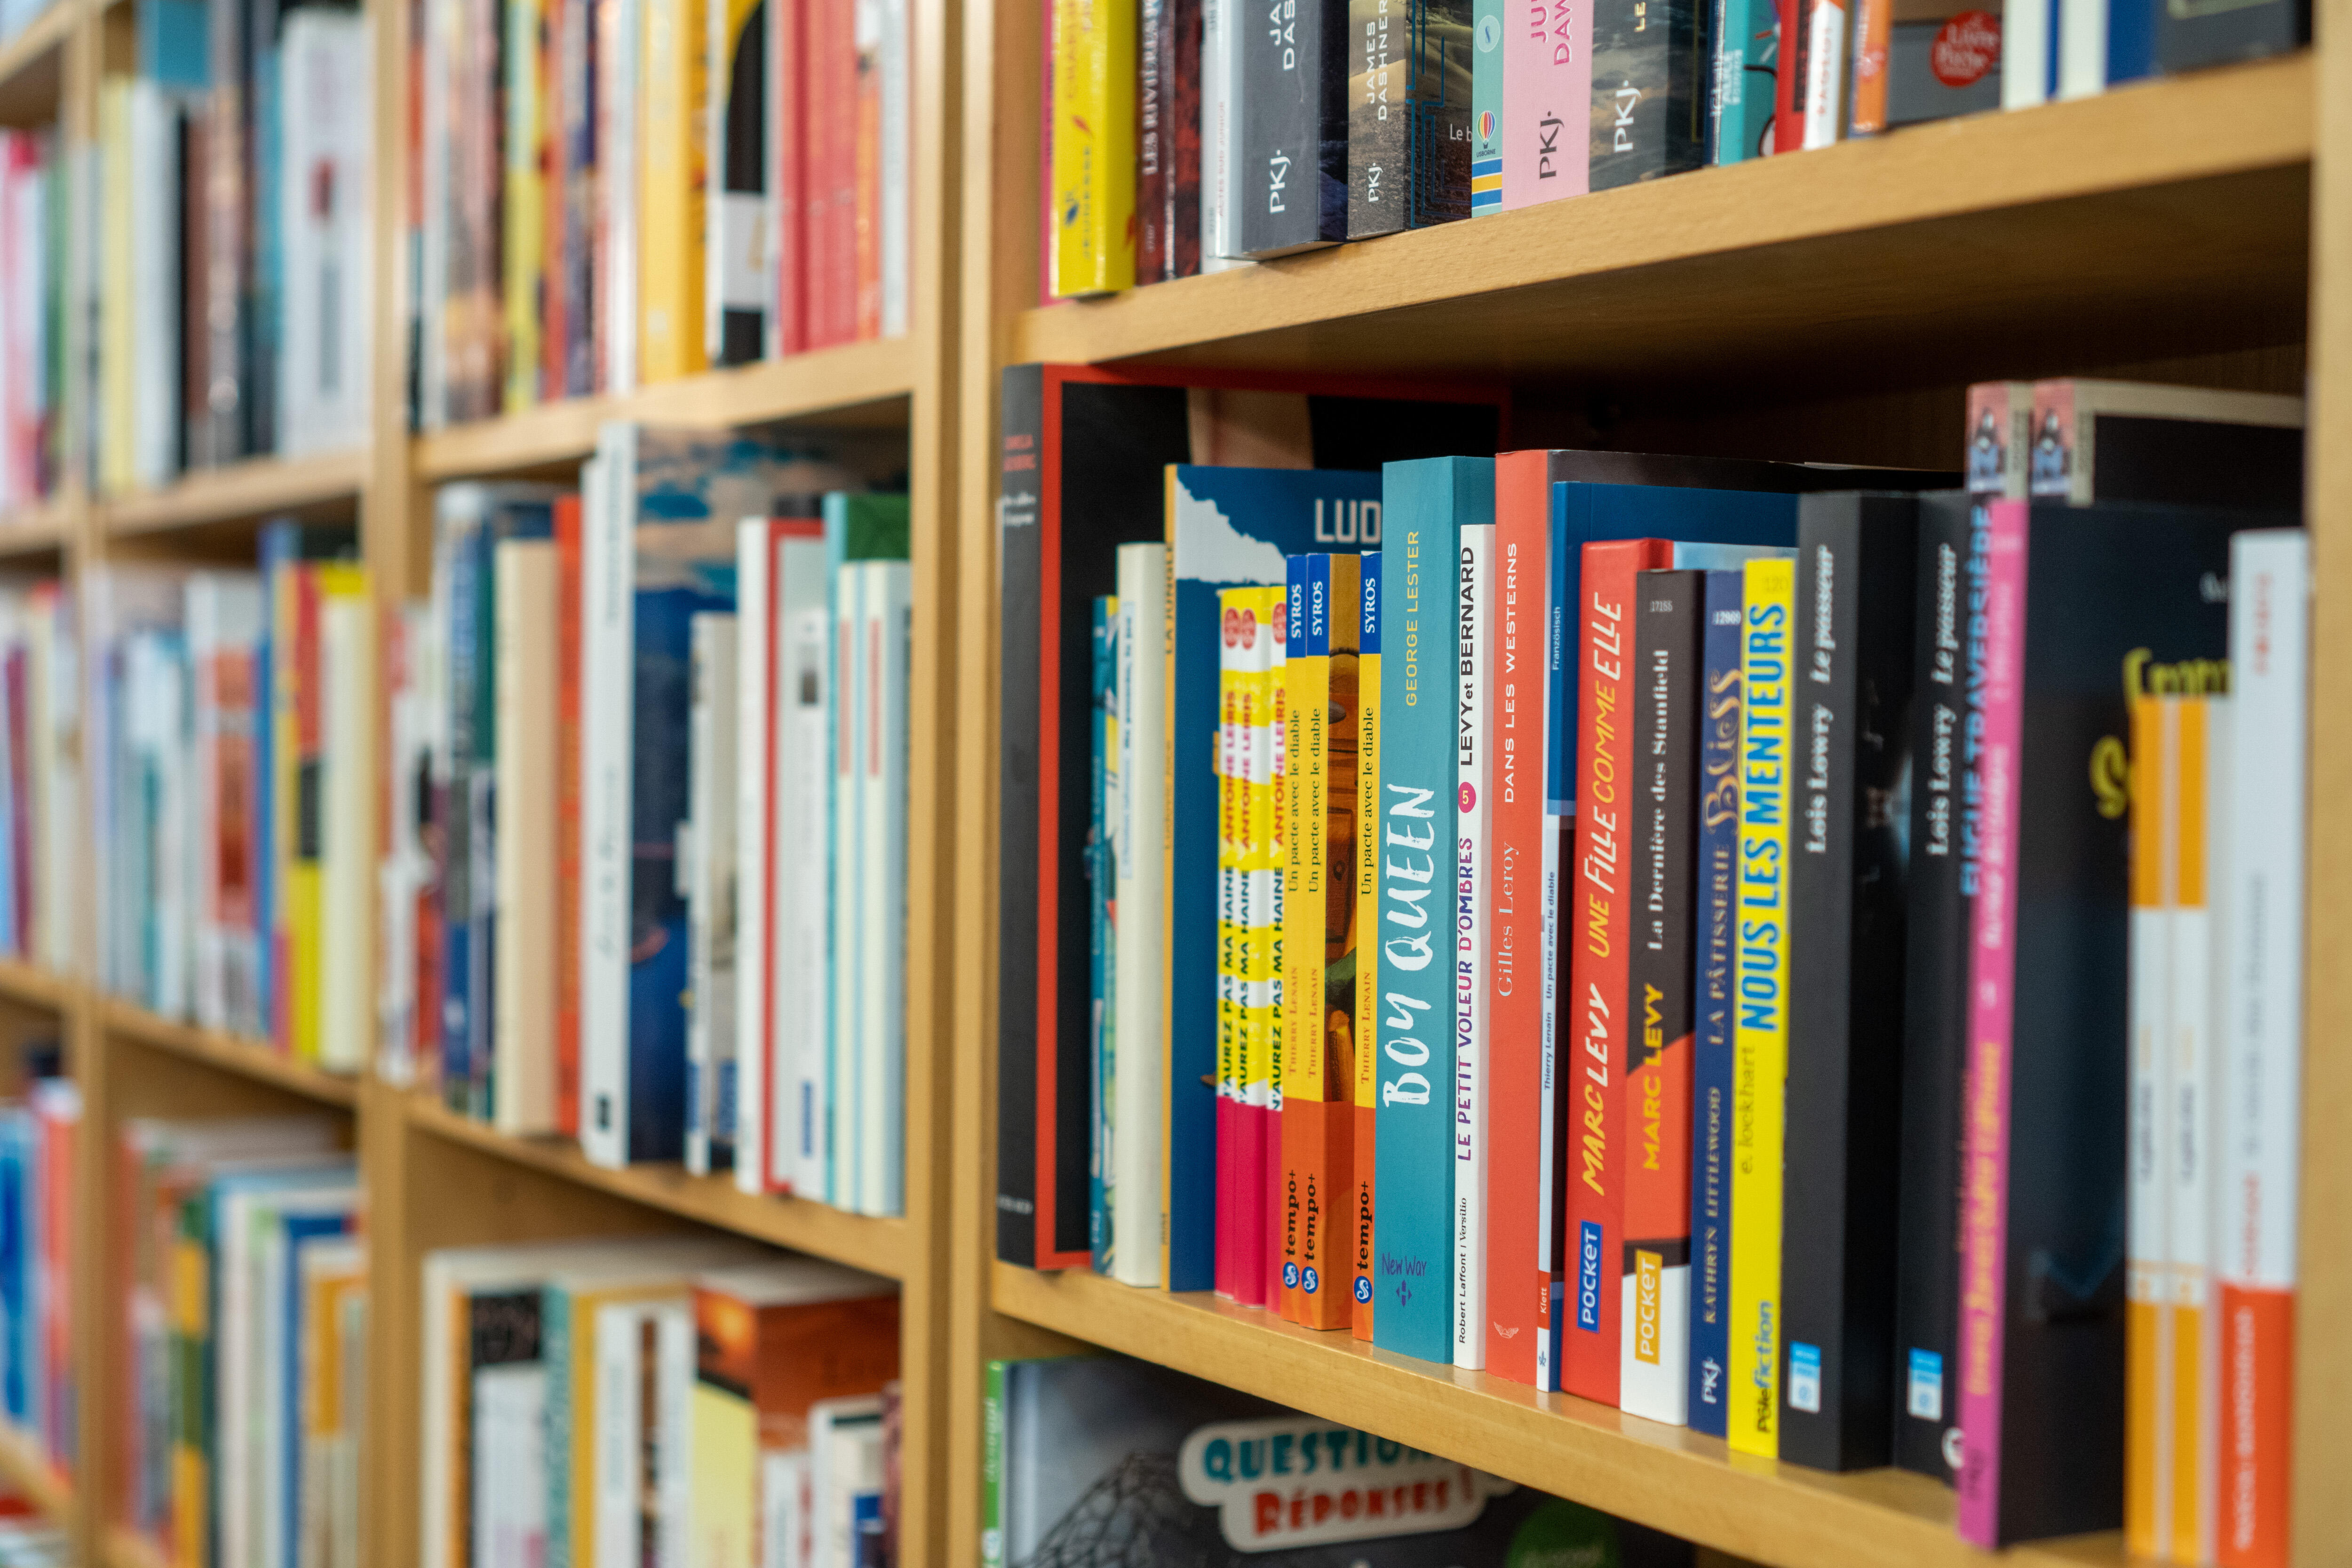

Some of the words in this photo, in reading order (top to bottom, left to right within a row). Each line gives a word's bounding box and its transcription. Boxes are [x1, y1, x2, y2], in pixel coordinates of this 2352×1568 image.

[1367, 21, 1376, 104] JAMES
[1378, 0, 1388, 121] DASHNER
[1449, 123, 1463, 141] Le
[1476, 148, 1496, 158] USBORNE
[1407, 531, 1419, 612] LESTER
[1291, 583, 1302, 638] SYROS
[1312, 581, 1323, 636] SYROS
[1365, 578, 1375, 634] SYROS
[1461, 547, 1474, 676] BERNARD
[1505, 543, 1517, 674] WESTERNS
[1591, 591, 1621, 681] ELLE
[1406, 620, 1418, 707] GEORGE
[1552, 606, 1560, 670] Französisch
[1809, 650, 1831, 685] Le
[1931, 650, 1954, 685] Le
[1275, 688, 1285, 747] LEIRIS
[1465, 683, 1473, 700] et
[1505, 683, 1515, 728] LES
[1652, 650, 1669, 755] Stanfield
[1745, 603, 1786, 825] MENTEURS
[1290, 709, 1300, 757] diable
[1311, 708, 1321, 757] diable
[1363, 707, 1374, 757] diable
[1461, 700, 1473, 766] LEVY
[1592, 680, 1616, 804] COMME
[1806, 703, 1834, 790] Lowry
[1928, 703, 1957, 791] Lowry
[1274, 753, 1285, 846] ANTOINE
[1290, 763, 1300, 776] le
[1291, 781, 1300, 817] avec
[1311, 762, 1320, 776] le
[1363, 762, 1373, 776] le
[1462, 790, 1470, 805] 5
[1505, 737, 1515, 803] DANS
[1650, 762, 1666, 802] des
[1290, 821, 1301, 866] pacte
[1311, 821, 1321, 866] pacte
[1363, 822, 1374, 868] pacte
[1805, 794, 1827, 853] Lois
[1926, 796, 1949, 856] Lois
[1288, 871, 1298, 892] Un
[1309, 871, 1319, 893] Un
[1361, 873, 1372, 896] Un
[1385, 783, 1434, 971] QUEEN
[1498, 842, 1519, 916] Leroy
[1647, 807, 1665, 912] Dernière
[1744, 837, 1782, 908] LES
[1224, 866, 1234, 928] HAINE
[1240, 870, 1249, 934] HAINE
[1274, 867, 1283, 931] HAINE
[1458, 837, 1473, 952] D'OMBRES
[1547, 909, 1555, 919] le
[1706, 844, 1730, 1000] PÂTISSERIE
[1224, 936, 1233, 969] MA
[1273, 939, 1283, 973] MA
[1589, 893, 1610, 958] UNE
[1647, 920, 1663, 950] La
[1240, 942, 1249, 974] MA
[1498, 926, 1513, 997] Gilles
[1741, 920, 1780, 1032] NOUS
[1224, 976, 1233, 1013] PAS
[1240, 982, 1249, 1020] PAS
[1273, 979, 1282, 1019] PAS
[1362, 972, 1371, 1021] LENAIN
[1458, 961, 1473, 1048] VOLEUR
[1546, 984, 1552, 999] Un
[1383, 992, 1431, 1107] BOY
[1585, 982, 1610, 1087] LEVY
[1643, 982, 1664, 1067] LEVY
[1708, 1010, 1725, 1044] LA
[1240, 1027, 1248, 1103] 'AUREZ
[1361, 1027, 1370, 1084] THIERRY
[1544, 1052, 1553, 1090] Thierry
[1458, 1055, 1471, 1124] PETIT
[1738, 1046, 1755, 1146] lockhart
[1457, 1133, 1471, 1161] LE
[1582, 1084, 1606, 1196] MARC
[1643, 1075, 1662, 1170] MARC
[1706, 1086, 1721, 1218] LITTLEWOOD
[1285, 1170, 1299, 1257] tempo+
[1304, 1173, 1319, 1261] tempo+
[1357, 1181, 1372, 1271] tempo+
[1705, 1226, 1718, 1324] KATHRYN
[1202, 1429, 1432, 1486] QUESTIO
